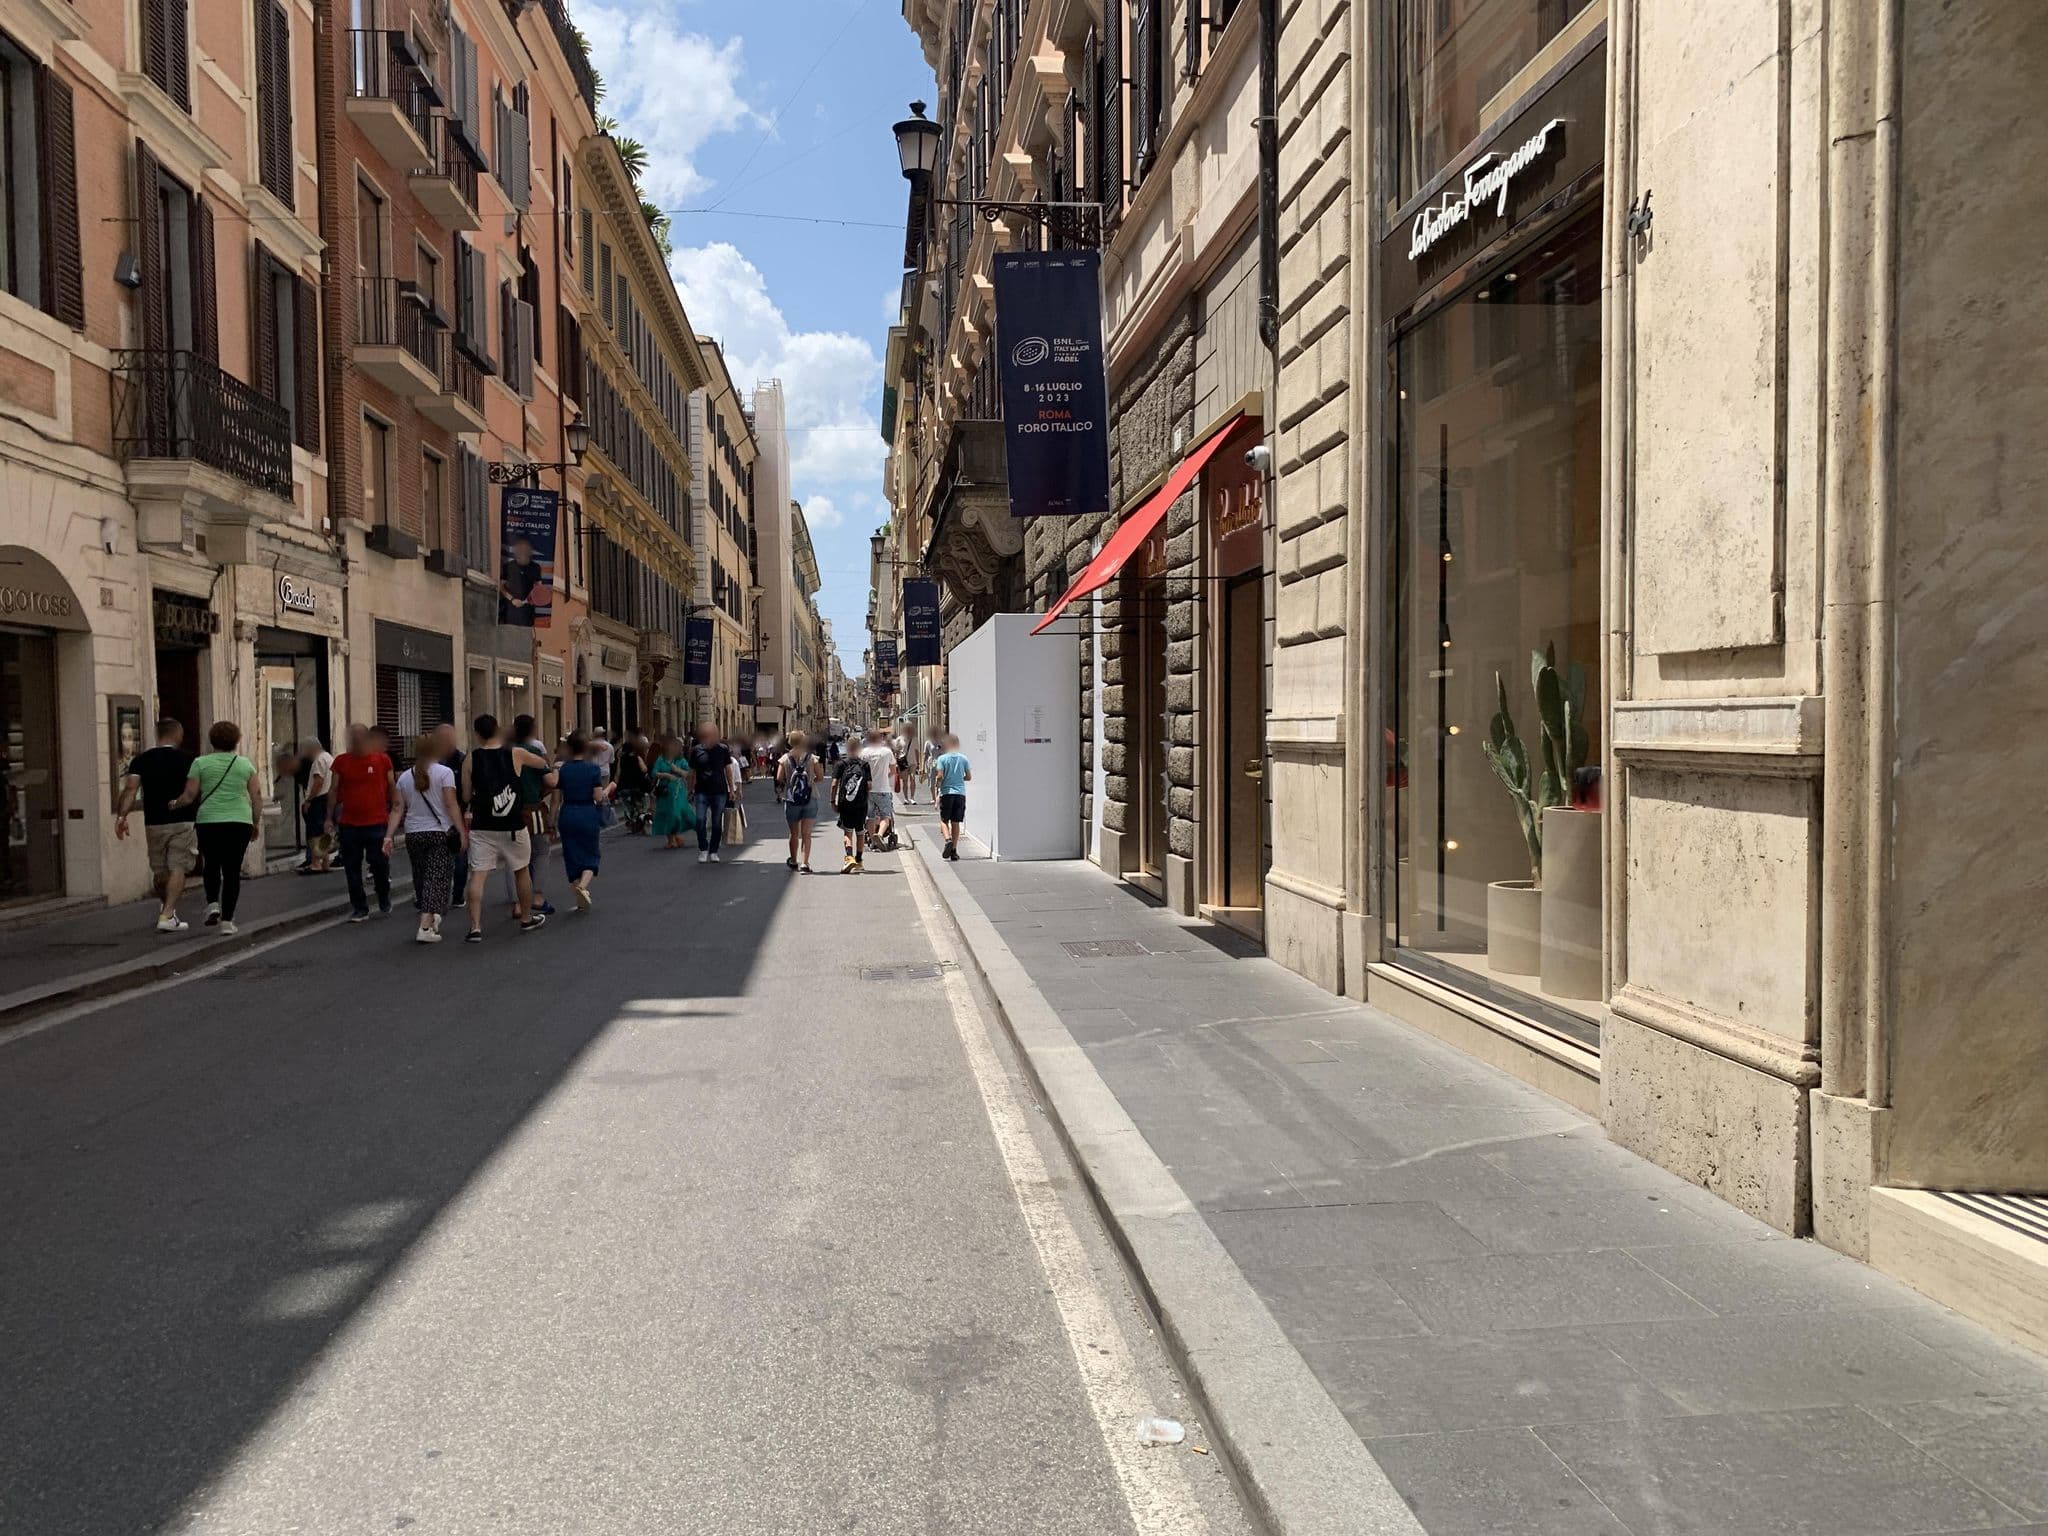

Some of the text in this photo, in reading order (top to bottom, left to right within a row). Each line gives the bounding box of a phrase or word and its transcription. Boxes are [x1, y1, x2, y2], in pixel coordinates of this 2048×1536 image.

[1627, 189, 1653, 238] 64
[1053, 355, 1081, 363] PADEL
[1046, 382, 1083, 392] LUGLIO
[1037, 409, 1072, 420] ROMA
[1017, 420, 1094, 434] FORO ITALICO
[493, 783, 513, 812] NIKE
